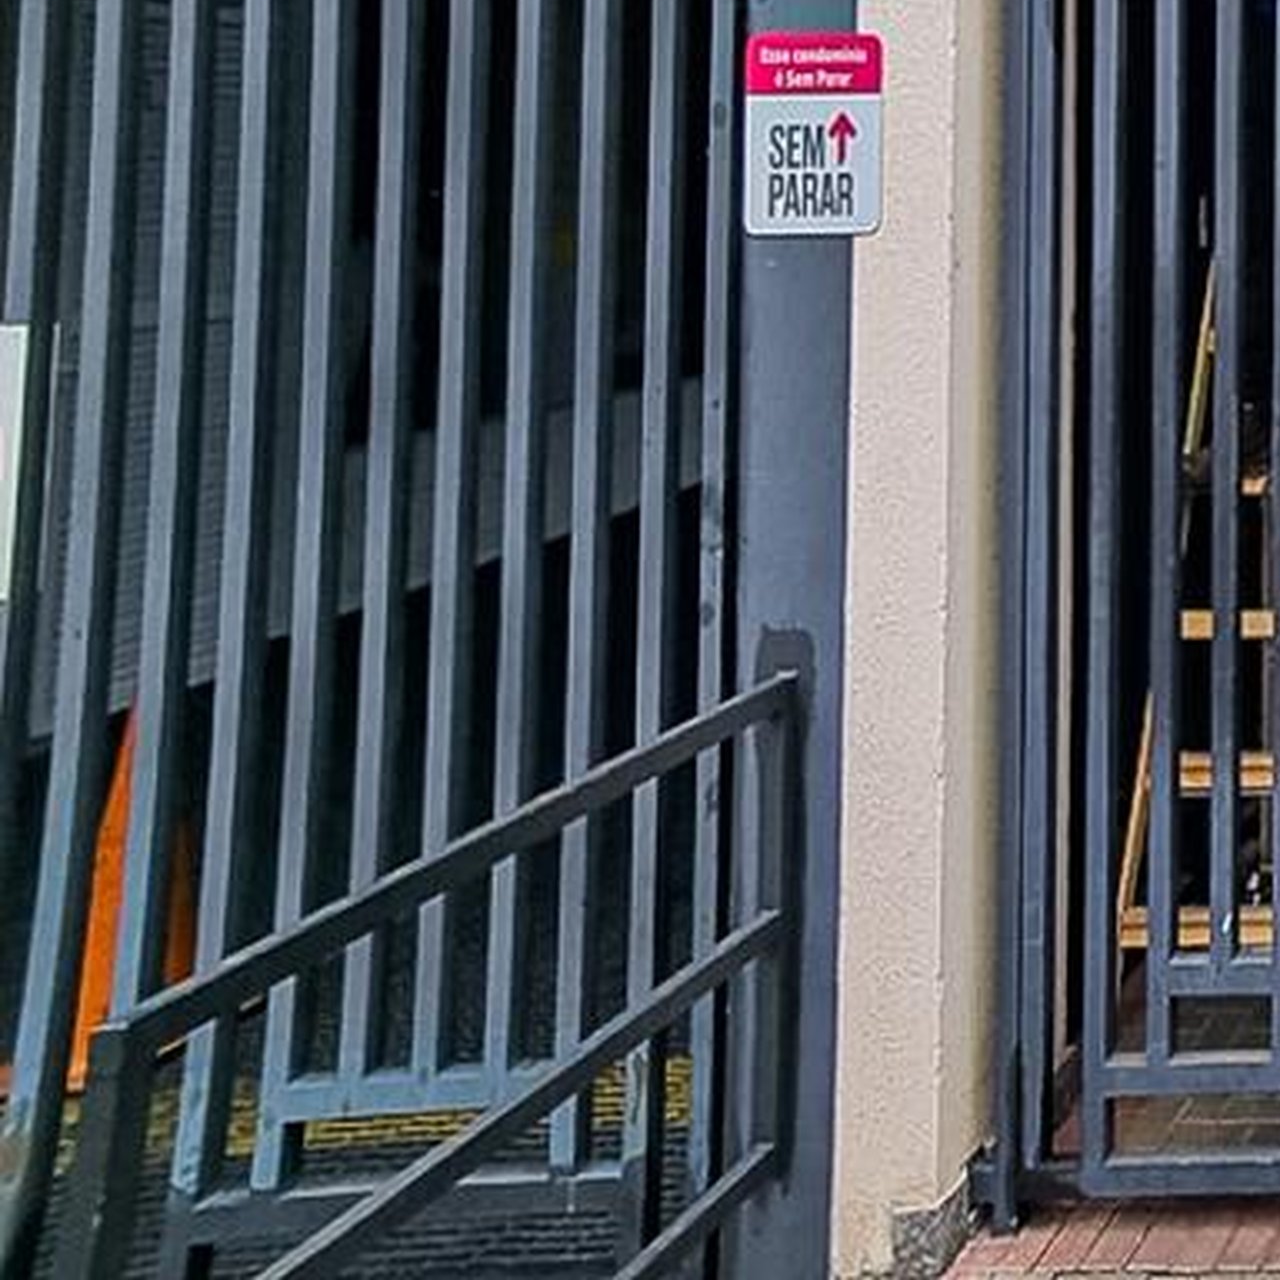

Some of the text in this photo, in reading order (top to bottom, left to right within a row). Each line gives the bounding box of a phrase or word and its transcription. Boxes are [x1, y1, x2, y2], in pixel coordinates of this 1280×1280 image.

[786, 69, 815, 88] Sem
[816, 69, 854, 88] Parar
[768, 123, 826, 170] SEM
[768, 173, 854, 217] PARAR
